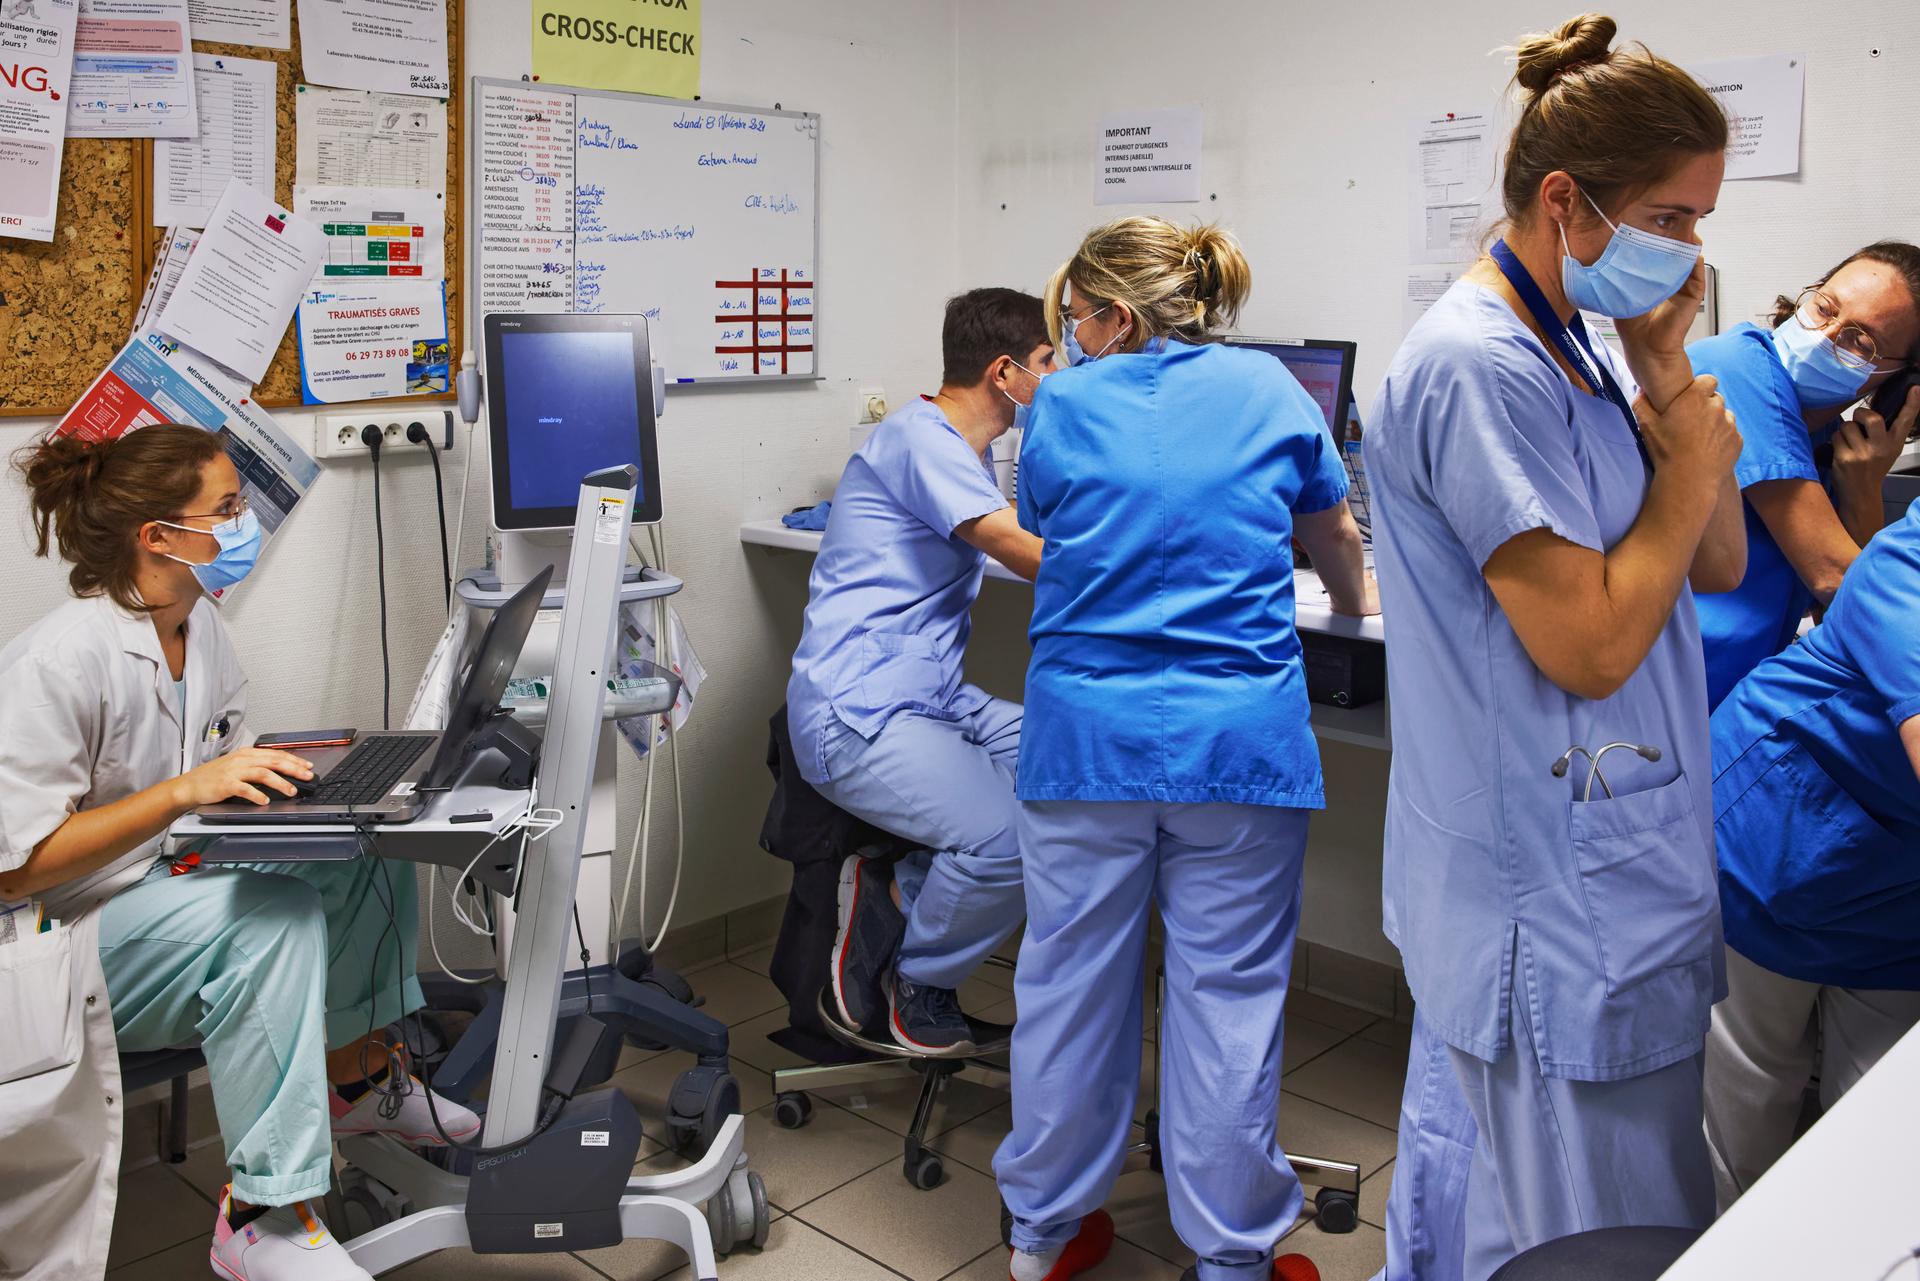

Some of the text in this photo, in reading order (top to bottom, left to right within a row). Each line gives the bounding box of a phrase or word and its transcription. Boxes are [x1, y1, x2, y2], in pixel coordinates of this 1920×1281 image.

[36, 29, 58, 37] rigide
[541, 12, 695, 56] CROSS-CHECK
[2, 39, 21, 48] jours
[36, 36, 56, 45] durée
[673, 112, 704, 129] Lundi
[706, 115, 715, 129] 8
[717, 111, 747, 131] Novembre
[1105, 127, 1151, 138] IMPORTANT
[1130, 153, 1153, 161] (ABEILLE)
[1148, 164, 1183, 172] L'INTERSALLE
[761, 269, 776, 277] IDE
[328, 307, 420, 320] TRAUMATISÉS GRAVES
[148, 334, 172, 357] chm
[1562, 333, 1580, 360] vacciner
[346, 348, 409, 361] 06 29 73 89 08
[187, 366, 226, 402] MÉDICAMENTS
[230, 403, 251, 423] RISQUE
[250, 421, 258, 430] ET
[257, 427, 274, 445] NEVER
[273, 442, 292, 462] EVENTS
[538, 416, 562, 424] mindray
